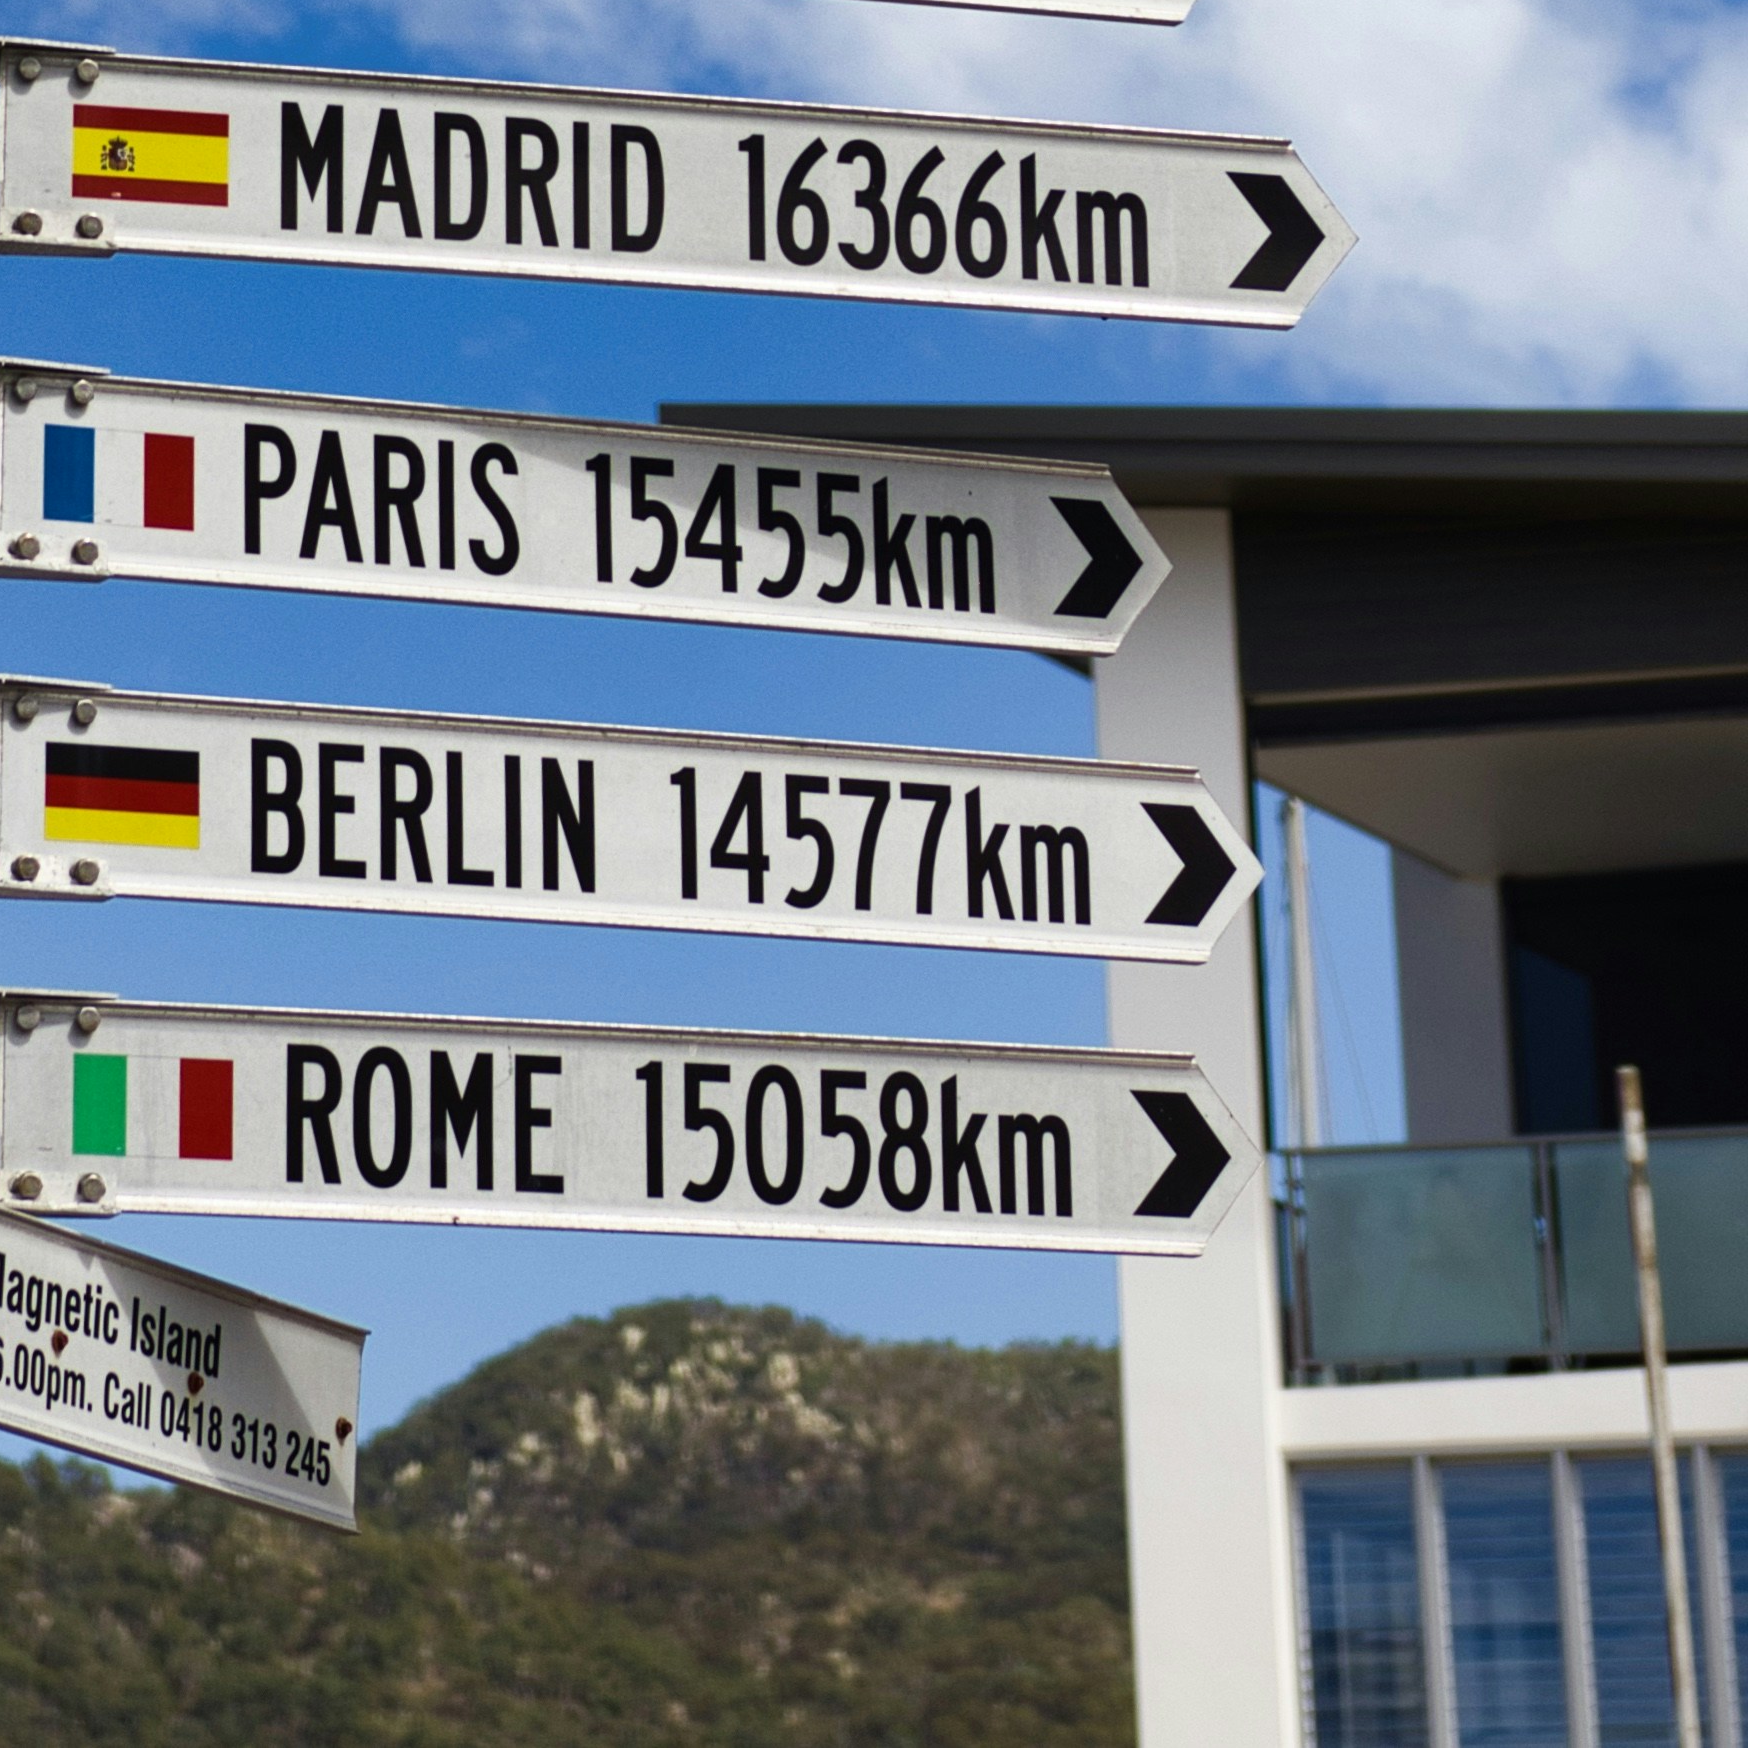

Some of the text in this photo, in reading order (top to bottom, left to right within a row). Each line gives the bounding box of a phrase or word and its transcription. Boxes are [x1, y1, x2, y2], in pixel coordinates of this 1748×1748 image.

[280, 101, 1150, 288] MADRID 16366km
[244, 423, 996, 615] PARIS 15455km
[250, 737, 1091, 926] BERLIN 14577km
[286, 1043, 1073, 1218] ROME 15058km
[130, 1296, 222, 1379] Island
[104, 1372, 152, 1430] Call
[160, 1390, 222, 1453] 0418
[231, 1413, 277, 1470] 313
[286, 1430, 331, 1487] 245
